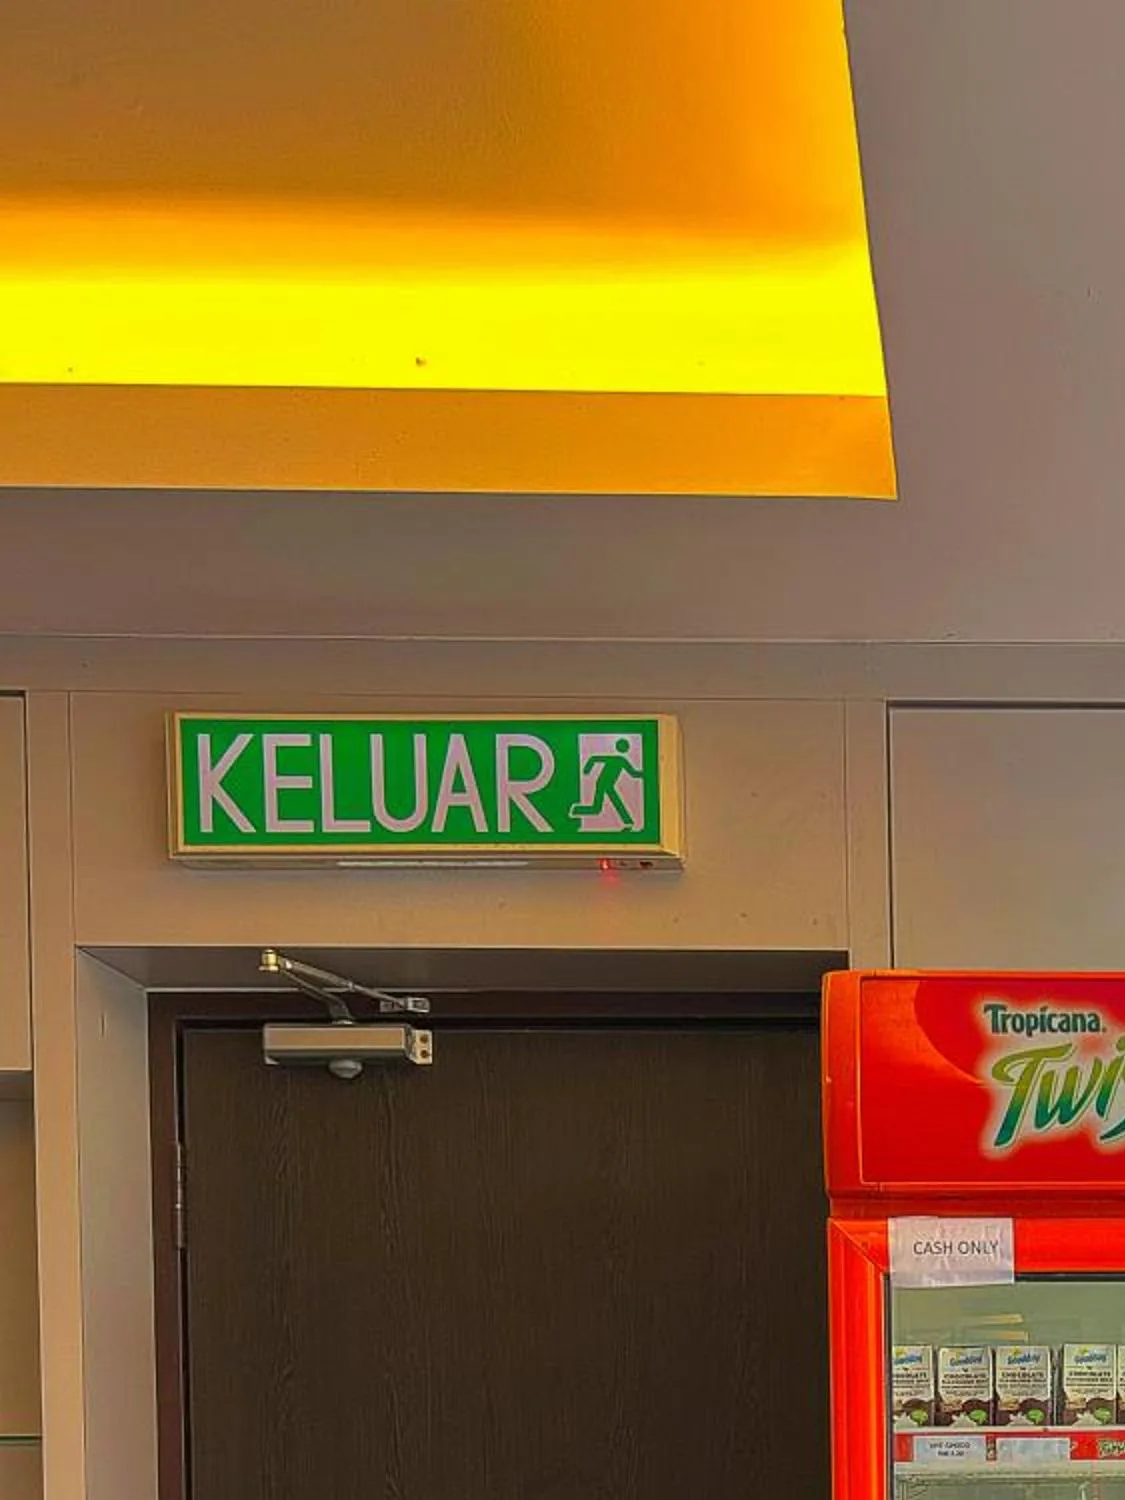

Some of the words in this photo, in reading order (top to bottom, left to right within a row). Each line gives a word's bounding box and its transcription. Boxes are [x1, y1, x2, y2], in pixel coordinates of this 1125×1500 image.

[197, 733, 556, 834] KELUAR
[984, 1003, 1102, 1037] Tropicana
[913, 1240, 953, 1255] CASH
[957, 1239, 999, 1255] ONLY
